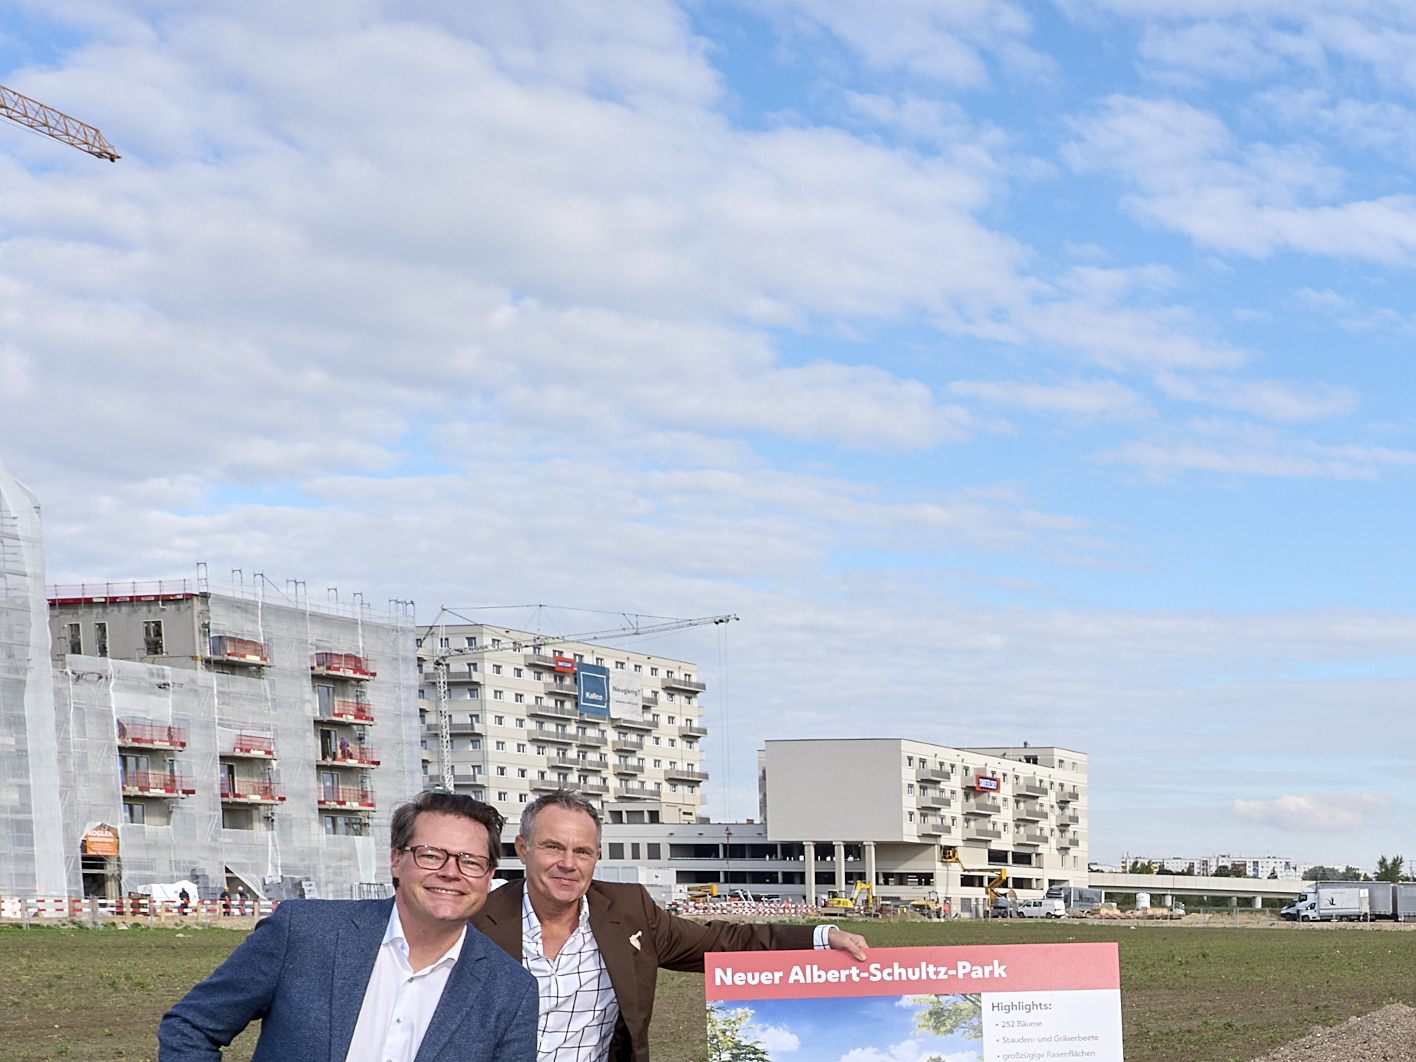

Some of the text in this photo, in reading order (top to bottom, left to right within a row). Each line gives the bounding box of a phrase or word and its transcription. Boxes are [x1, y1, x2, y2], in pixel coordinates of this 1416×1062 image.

[714, 960, 1008, 986] Neuer Albert-Schultz-Park
[991, 1001, 1053, 1014] Highlights:
[1002, 1034, 1099, 1044] Stauden- und Gräserbeete
[1002, 1050, 1096, 1061] großzügige Rasenflächen
